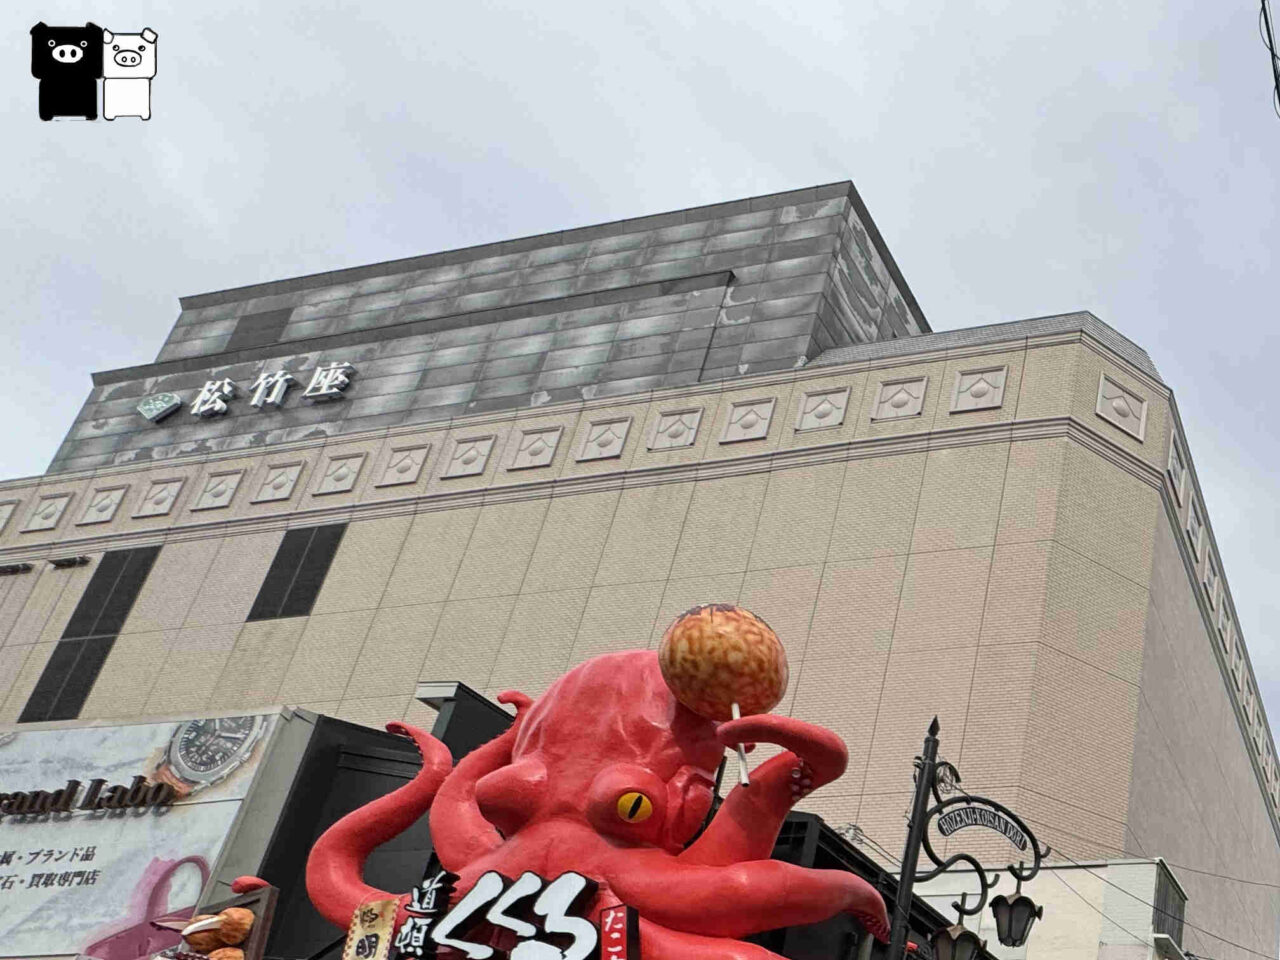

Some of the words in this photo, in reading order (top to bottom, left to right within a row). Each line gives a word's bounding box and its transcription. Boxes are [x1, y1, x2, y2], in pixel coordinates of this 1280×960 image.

[190, 362, 356, 418] 松竹座
[77, 775, 178, 811] Labo
[1006, 823, 1026, 847] DORI
